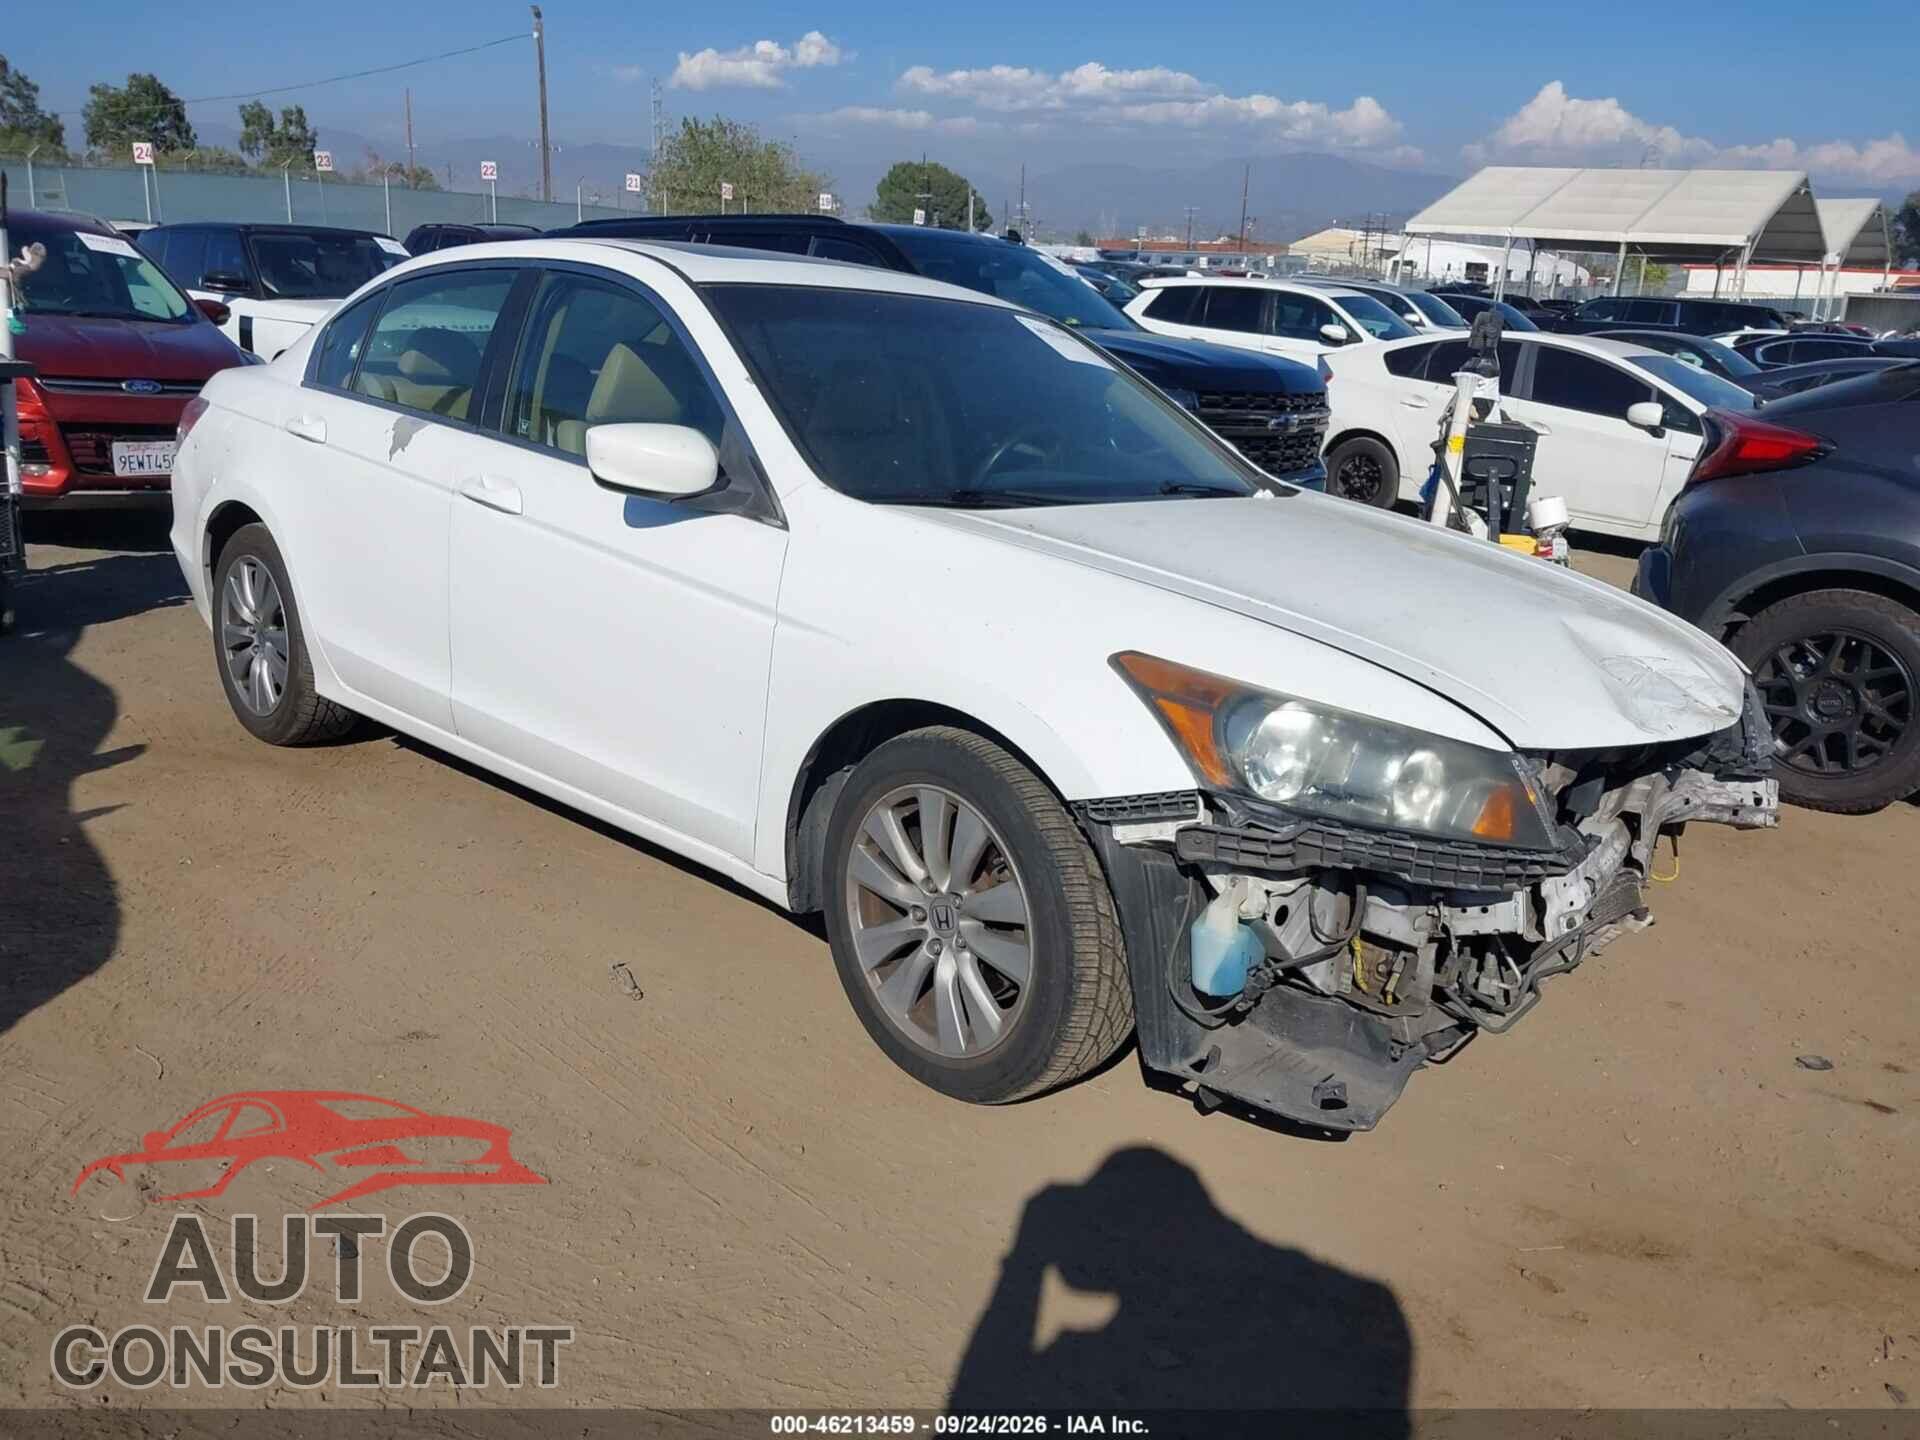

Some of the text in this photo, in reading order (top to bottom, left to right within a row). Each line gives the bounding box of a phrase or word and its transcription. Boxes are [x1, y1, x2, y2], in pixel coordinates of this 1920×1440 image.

[135, 146, 153, 159] 24
[317, 154, 331, 168] 23
[482, 165, 496, 176] 22
[627, 177, 639, 188] 21
